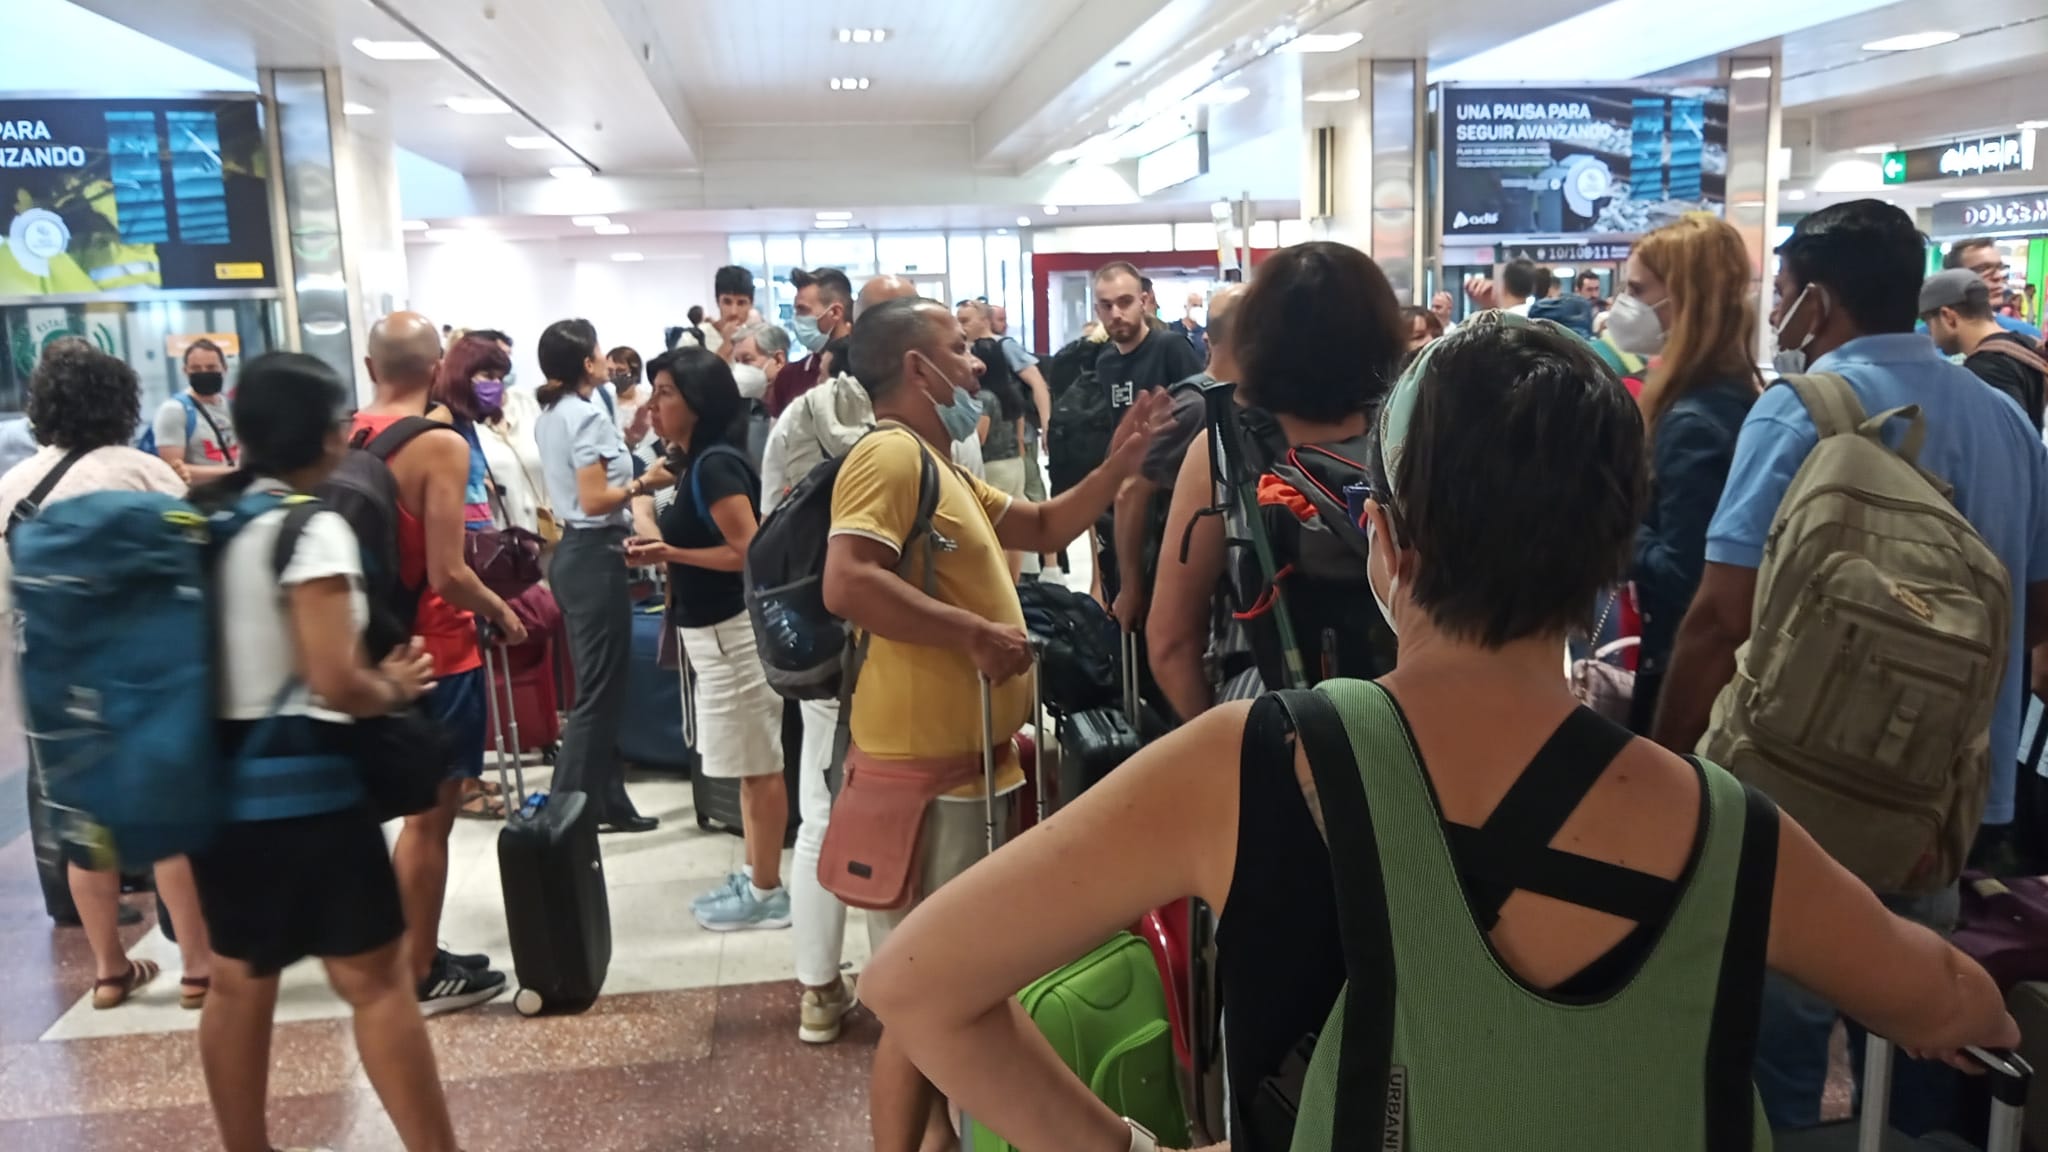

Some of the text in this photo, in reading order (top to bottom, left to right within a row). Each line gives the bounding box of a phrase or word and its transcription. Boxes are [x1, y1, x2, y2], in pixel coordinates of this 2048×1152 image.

[1456, 103, 1591, 120] UNA PAUSA PARA
[0, 120, 52, 140] ARA
[1456, 122, 1611, 141] SEGUIR AVANZANDO
[1384, 1073, 1402, 1152] URBANI
